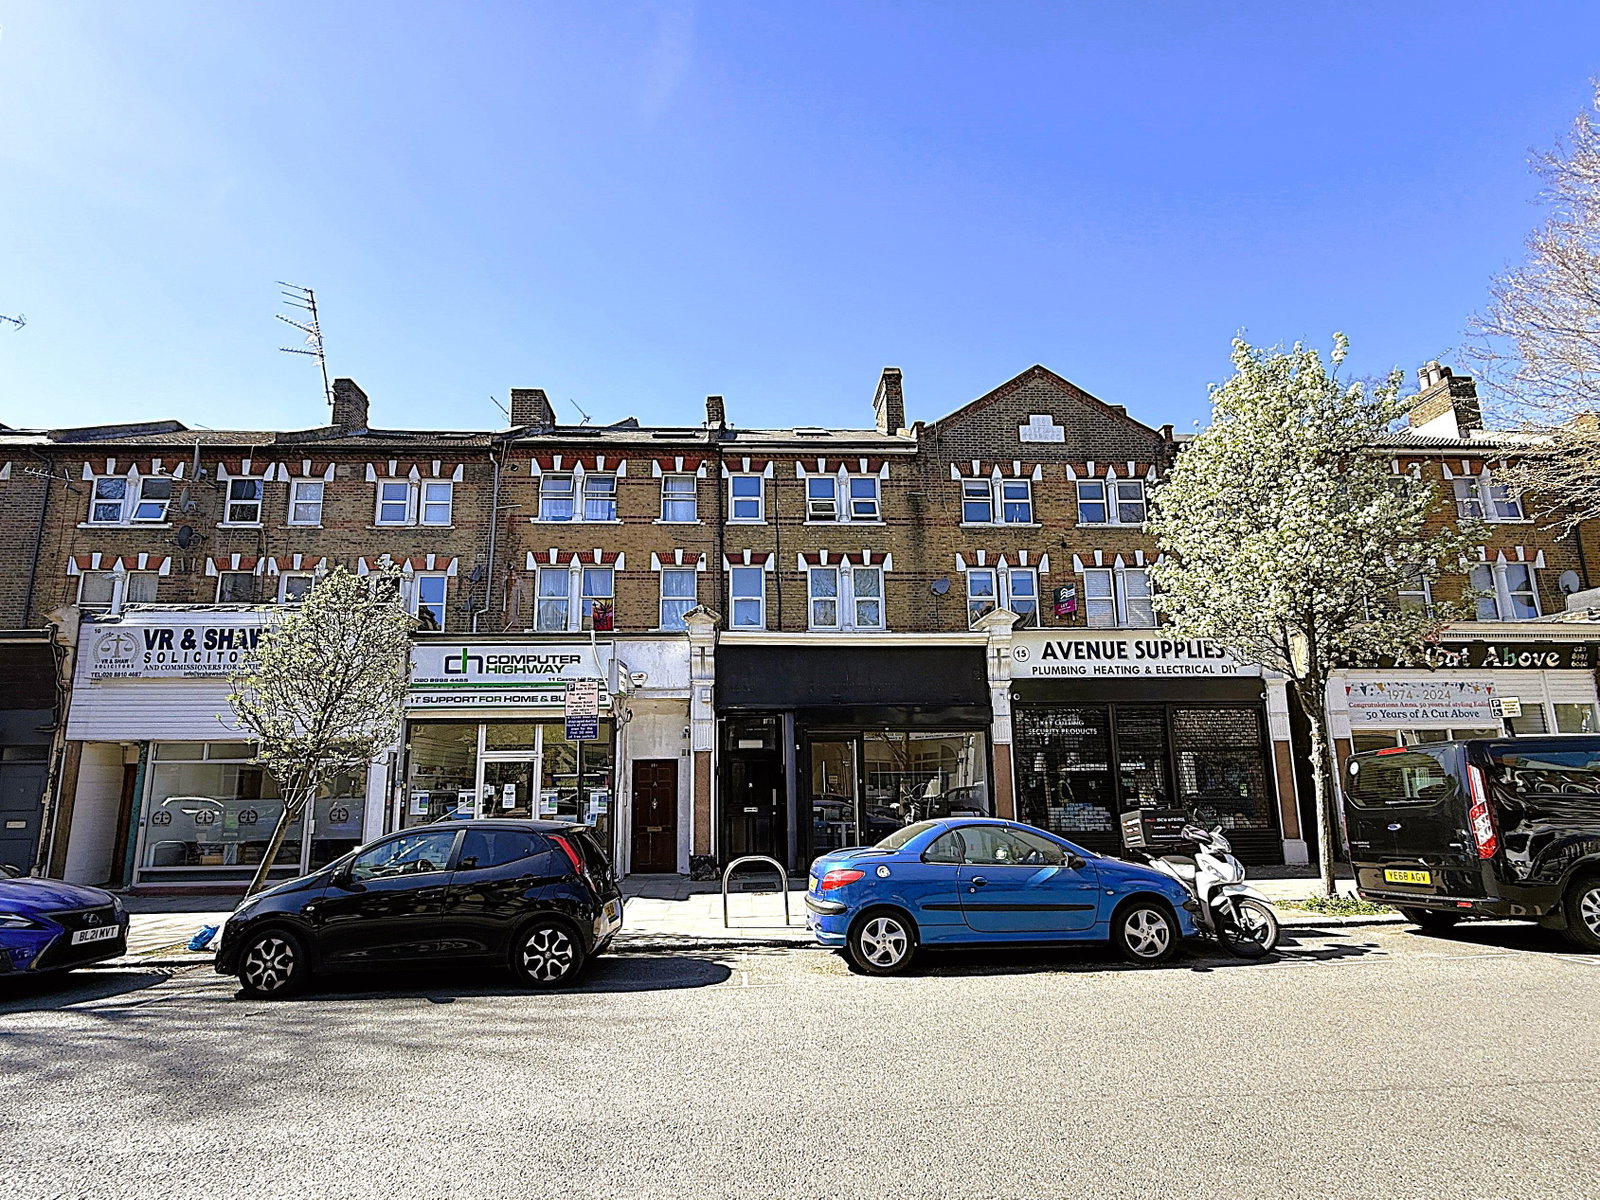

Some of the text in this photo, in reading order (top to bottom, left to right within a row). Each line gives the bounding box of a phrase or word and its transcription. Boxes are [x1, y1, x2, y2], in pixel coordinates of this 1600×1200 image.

[143, 628, 174, 650] VR
[180, 628, 197, 650] &
[1016, 649, 1027, 658] 15
[1041, 640, 1226, 660] AVENUE SUPPLIES
[486, 654, 581, 664] COMPUTER
[1481, 646, 1560, 667] Above
[486, 664, 565, 674] HIGHWAY
[1032, 664, 1238, 675] PLUMBING HEATING & ELECTRICAL DIY
[478, 695, 502, 703] FOR
[503, 695, 539, 703] HOME
[1387, 690, 1413, 699] 1974
[1423, 690, 1451, 700] 2024
[1366, 709, 1480, 720] 50 Years of A Cut Above
[1388, 871, 1426, 882] YE68 AGV
[79, 928, 98, 942] BL21
